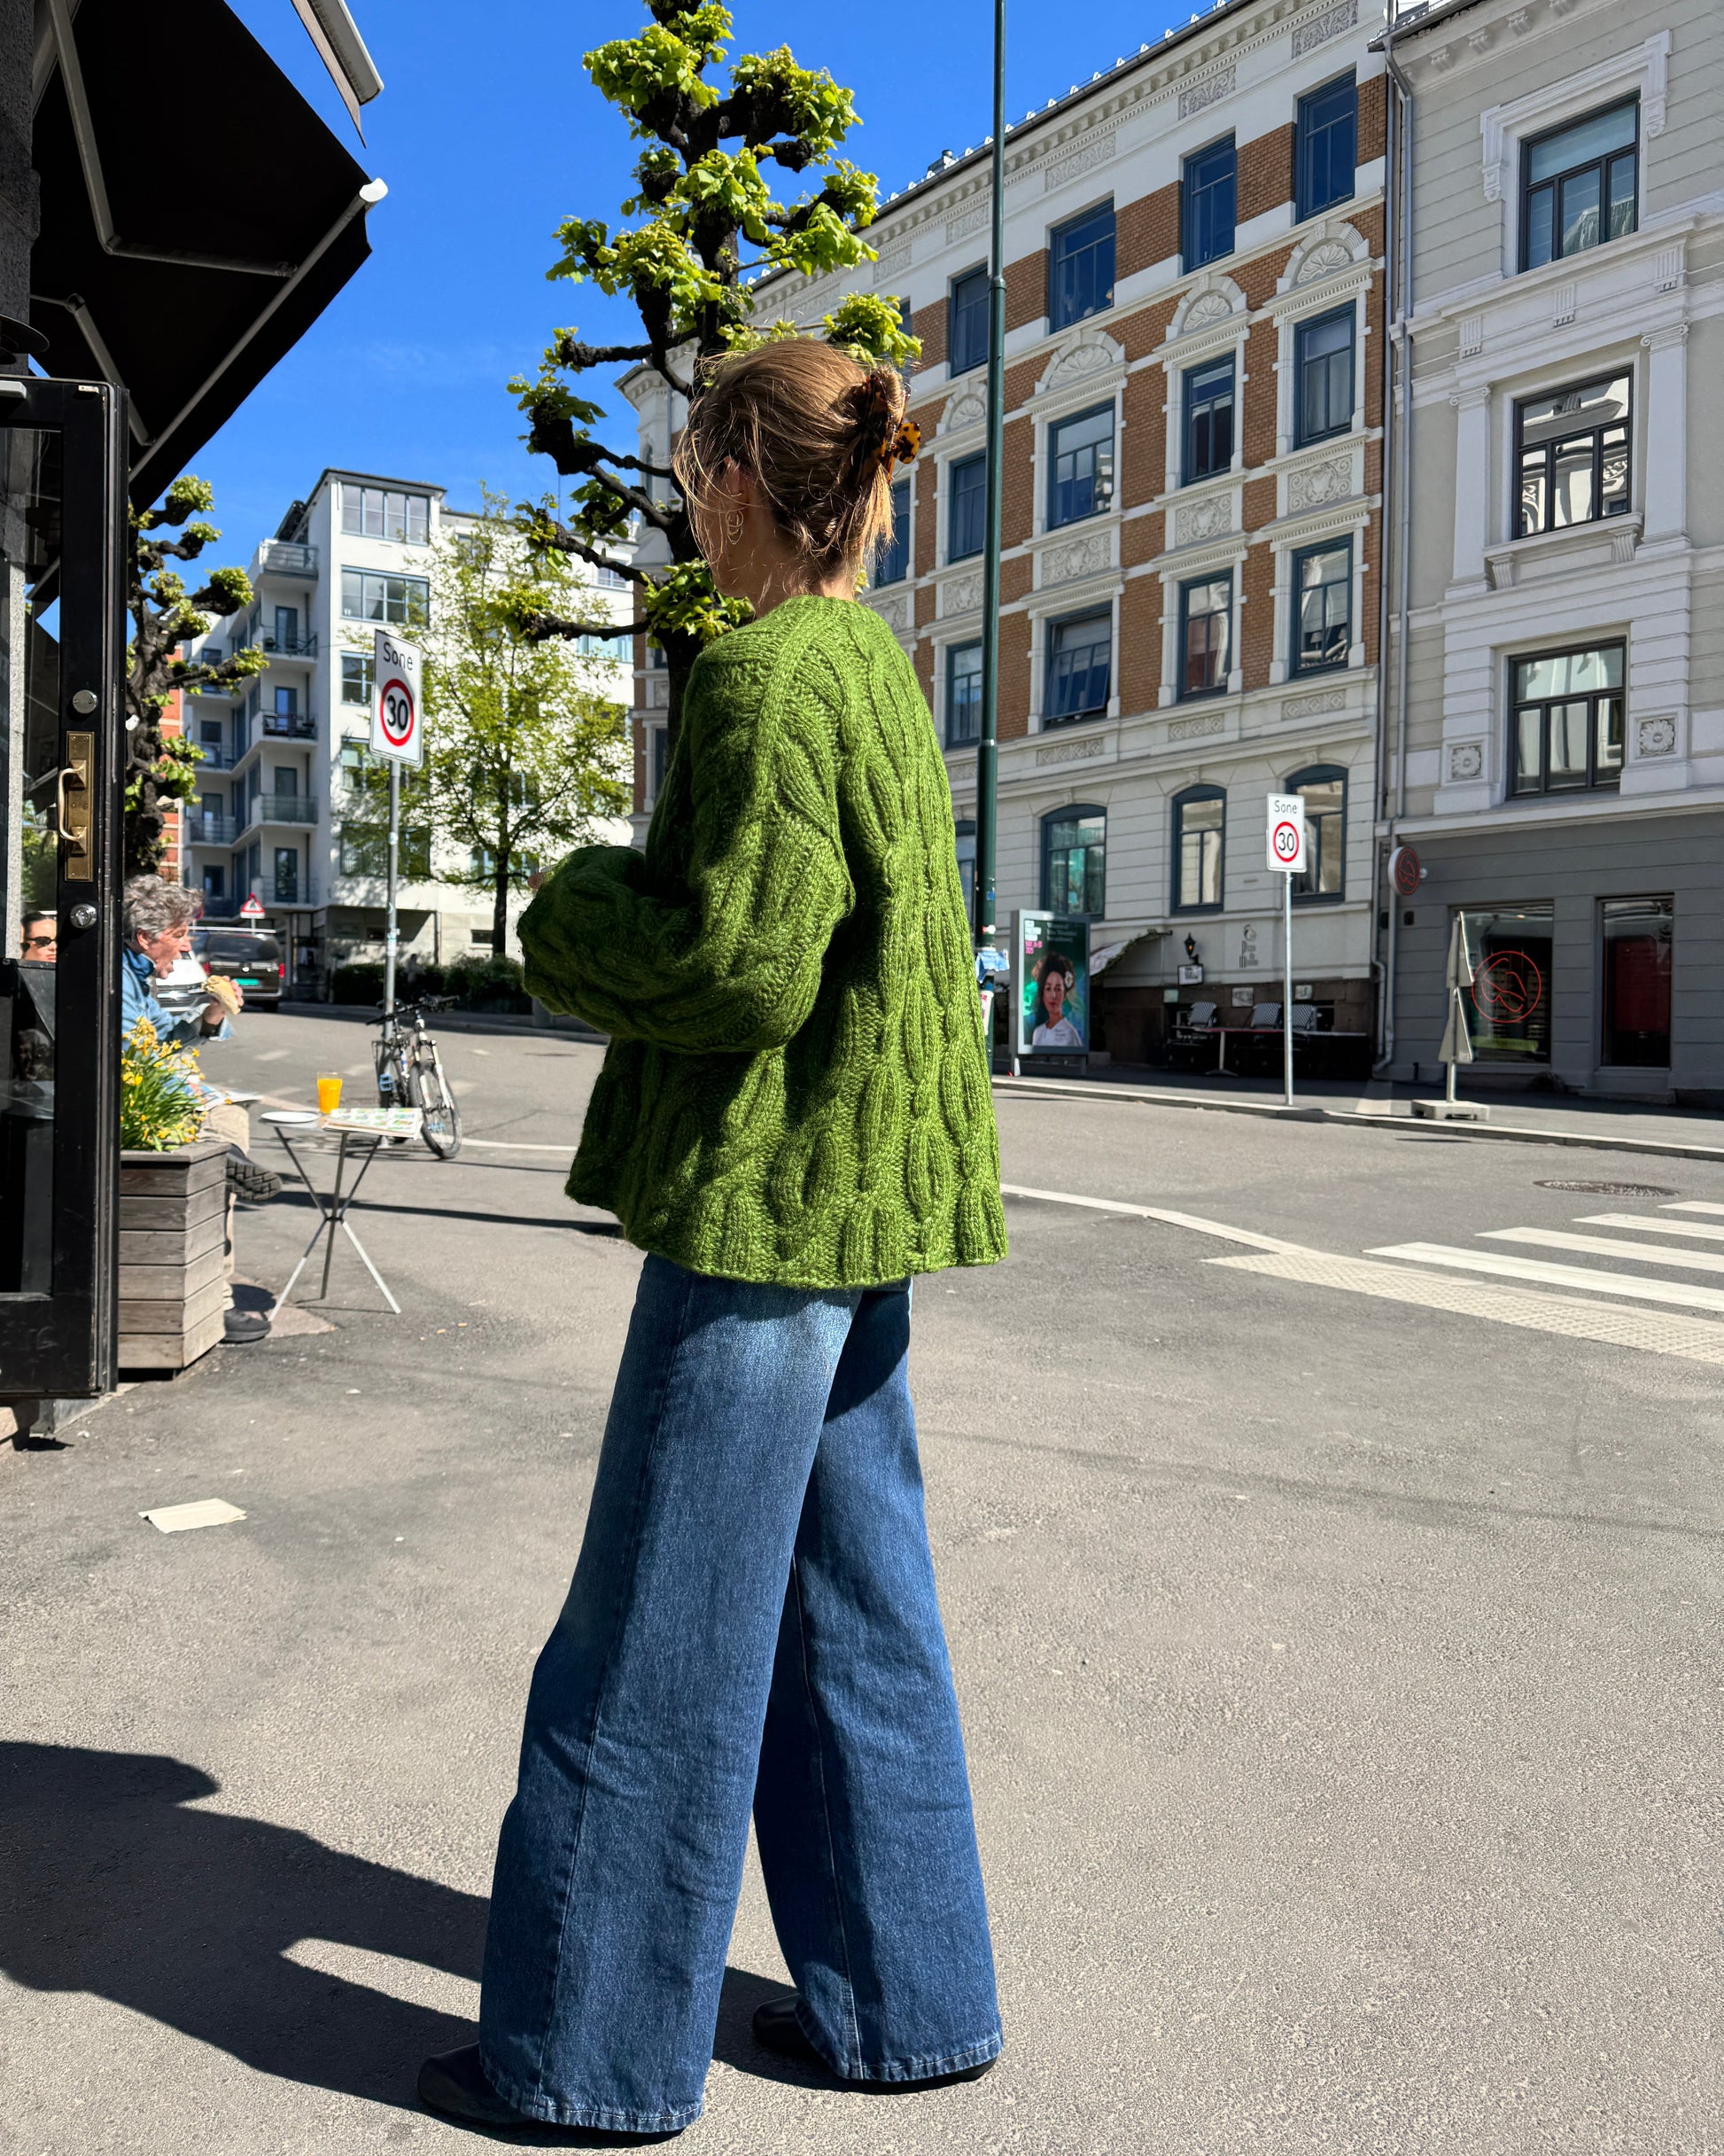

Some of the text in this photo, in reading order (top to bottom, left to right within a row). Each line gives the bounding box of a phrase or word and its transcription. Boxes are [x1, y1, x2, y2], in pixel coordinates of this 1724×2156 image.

[383, 642, 413, 671] Sone
[386, 694, 408, 732] 30
[1274, 800, 1298, 814] Sone
[1278, 832, 1294, 852] 30
